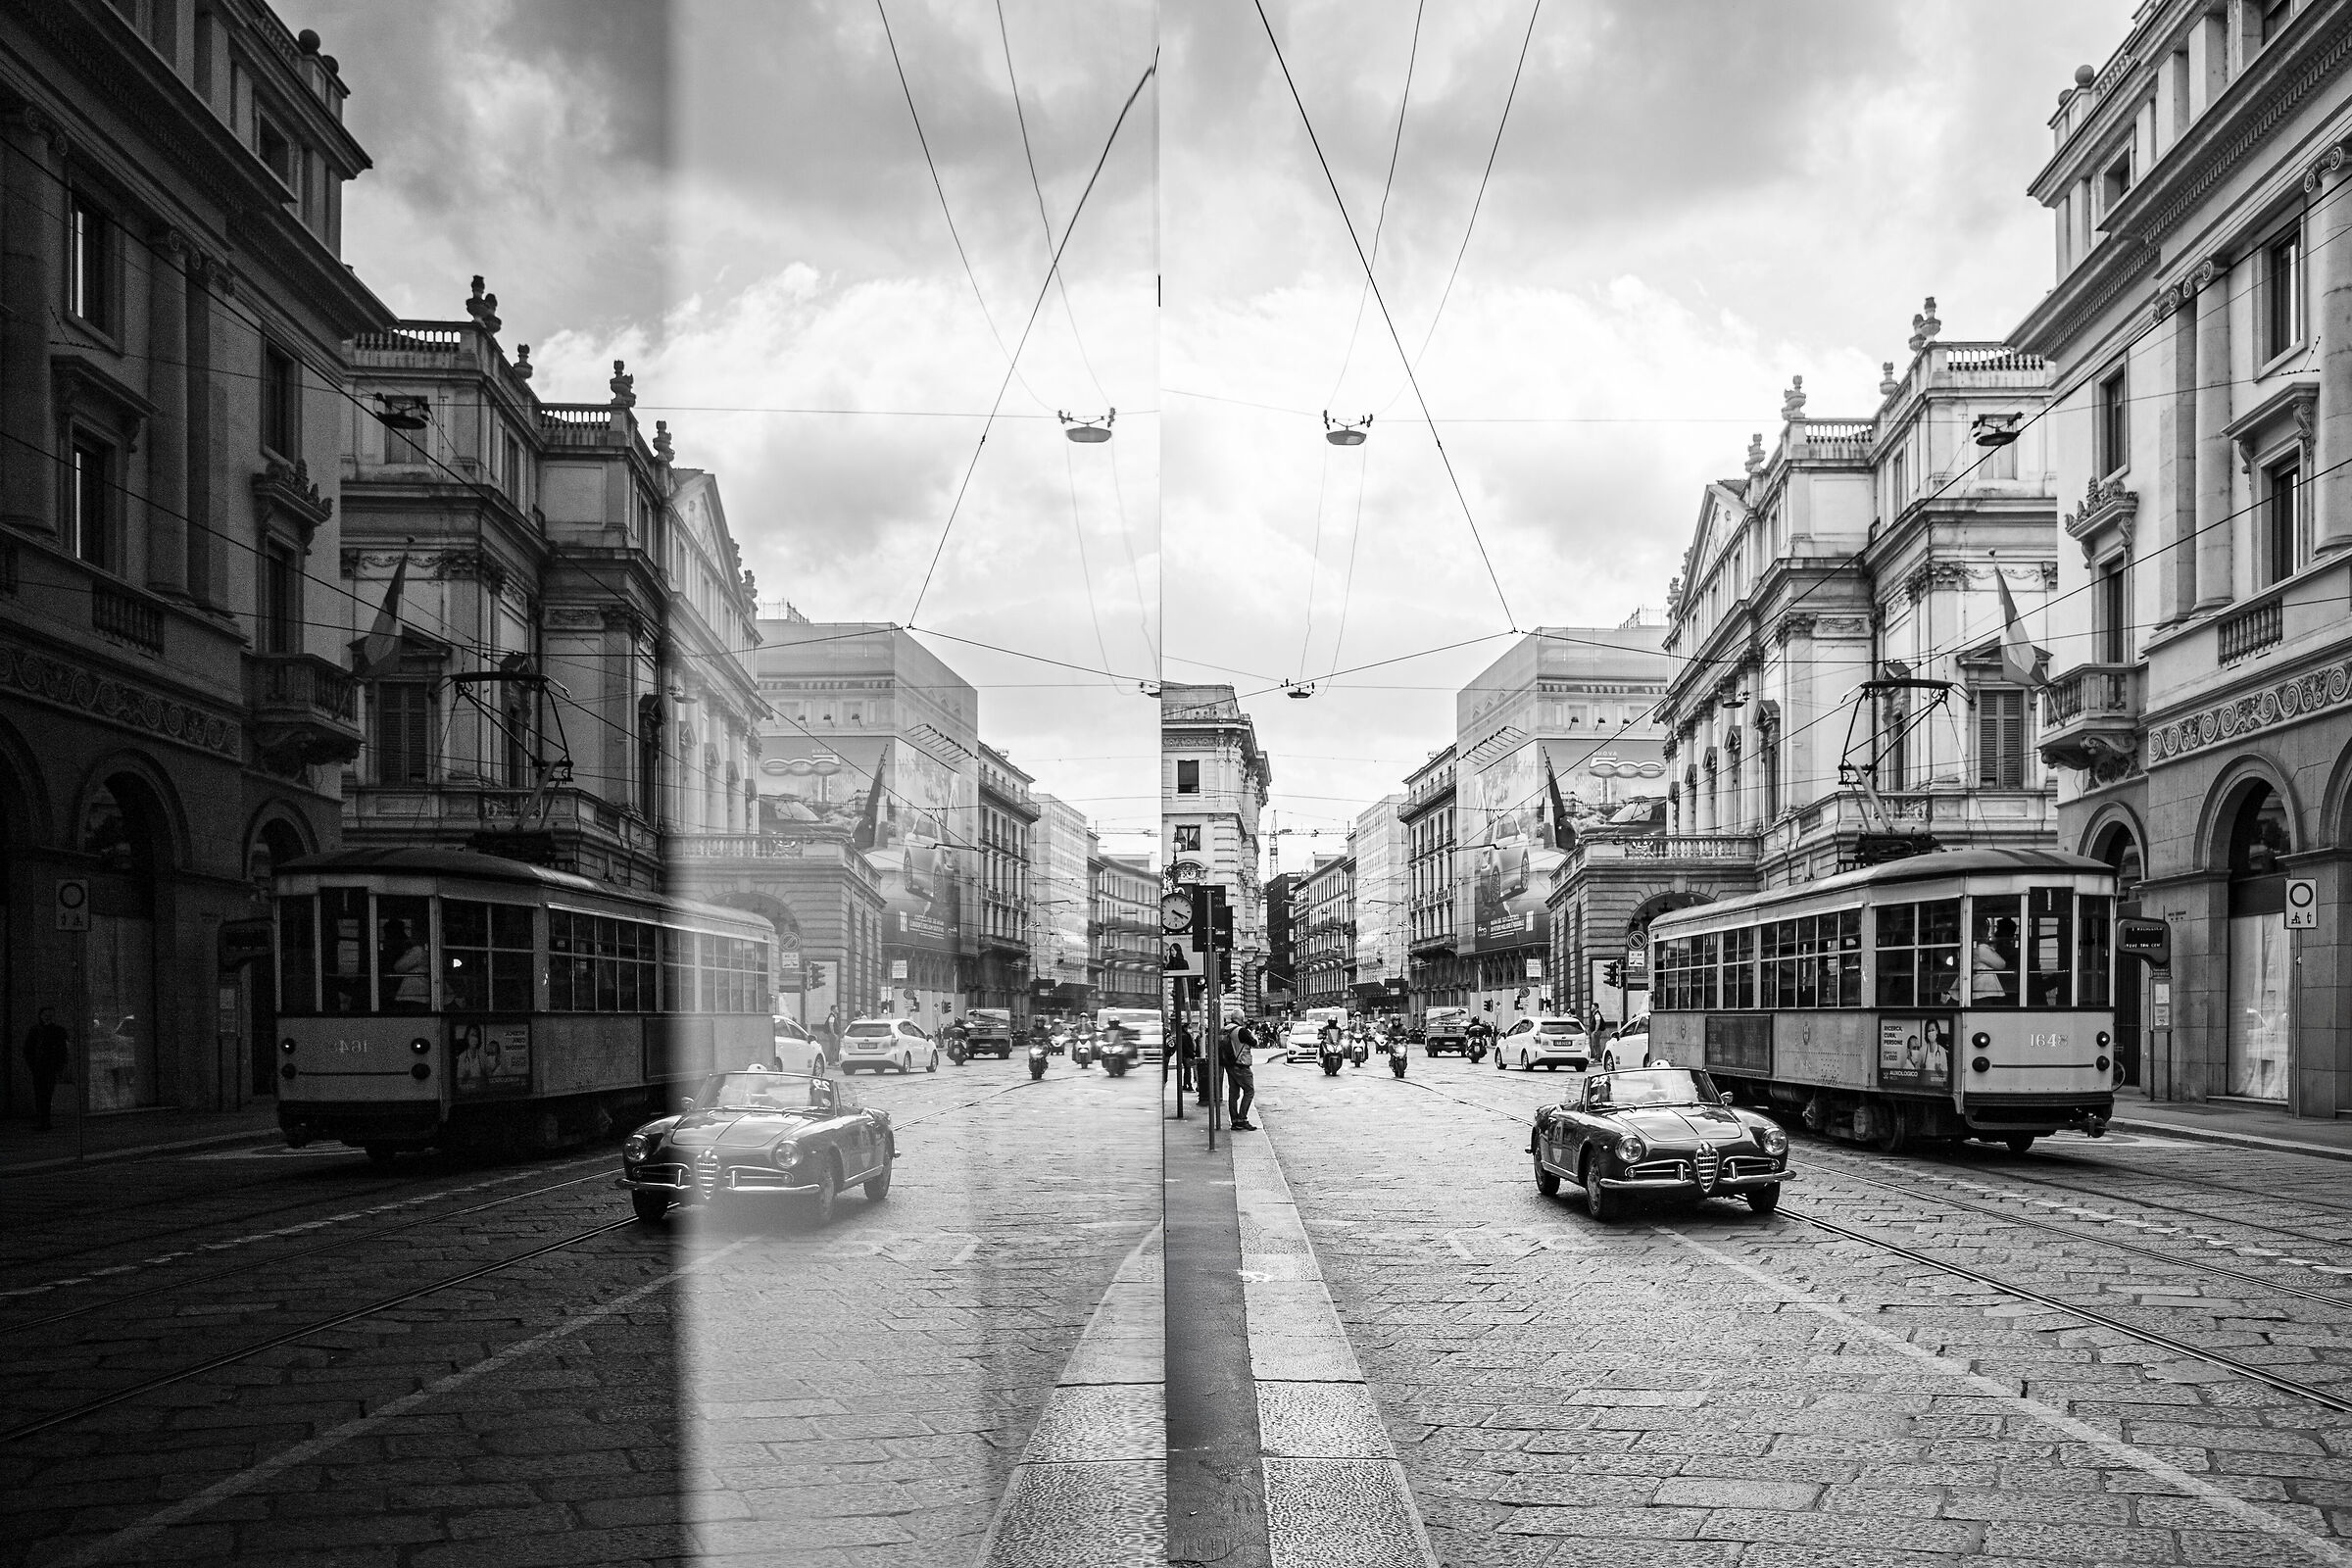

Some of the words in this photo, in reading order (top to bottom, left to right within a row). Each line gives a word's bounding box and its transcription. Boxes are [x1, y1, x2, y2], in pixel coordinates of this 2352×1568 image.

[1589, 757, 1666, 779] 500
[2030, 1033, 2069, 1048] 1648
[1591, 1076, 1607, 1088] 29
